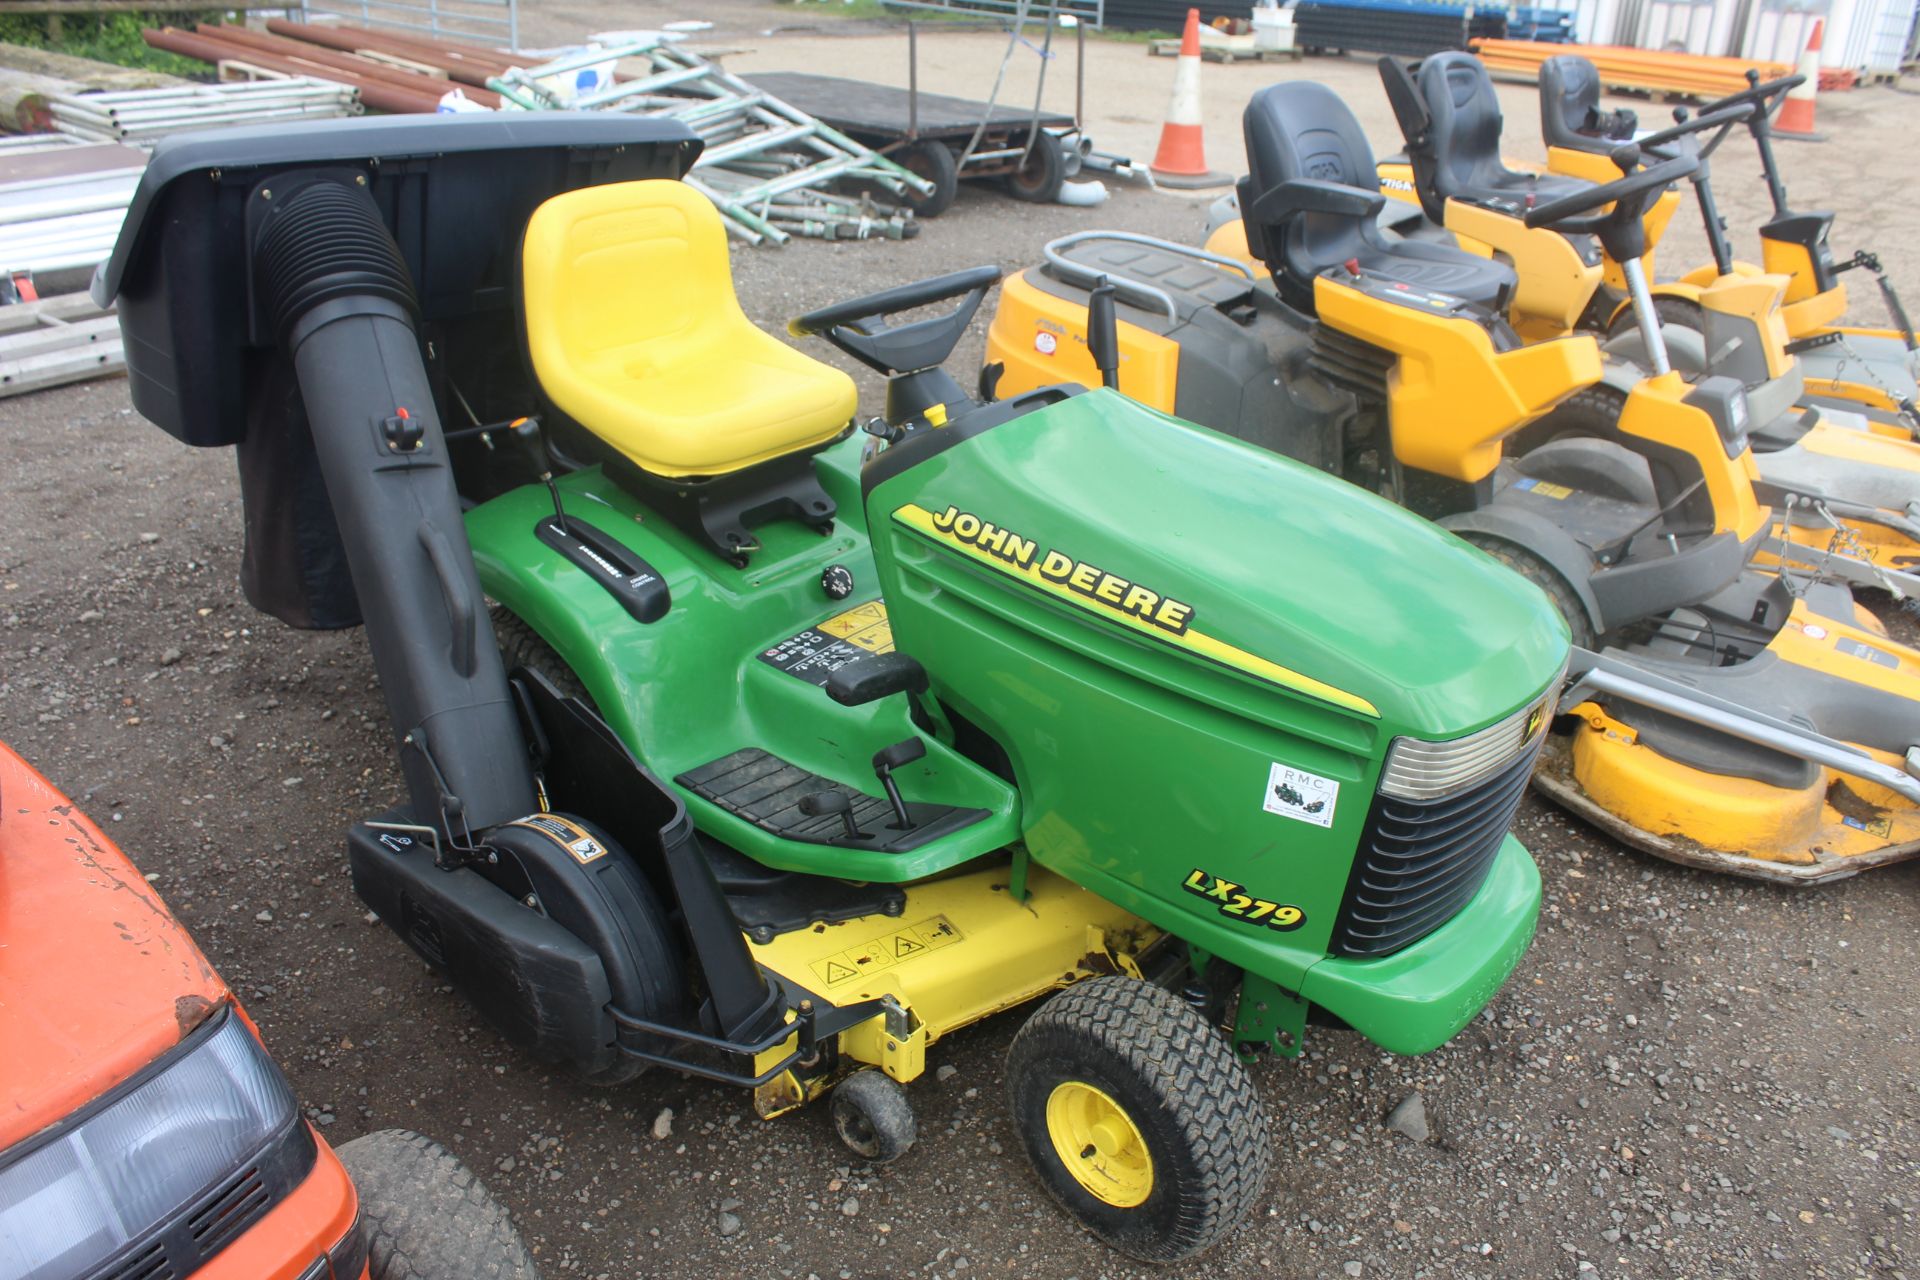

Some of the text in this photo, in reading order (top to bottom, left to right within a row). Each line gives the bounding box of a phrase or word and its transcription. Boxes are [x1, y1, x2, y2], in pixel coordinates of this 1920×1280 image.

[932, 506, 1194, 634] JOHN DEERE
[1183, 869, 1304, 930] LX279
